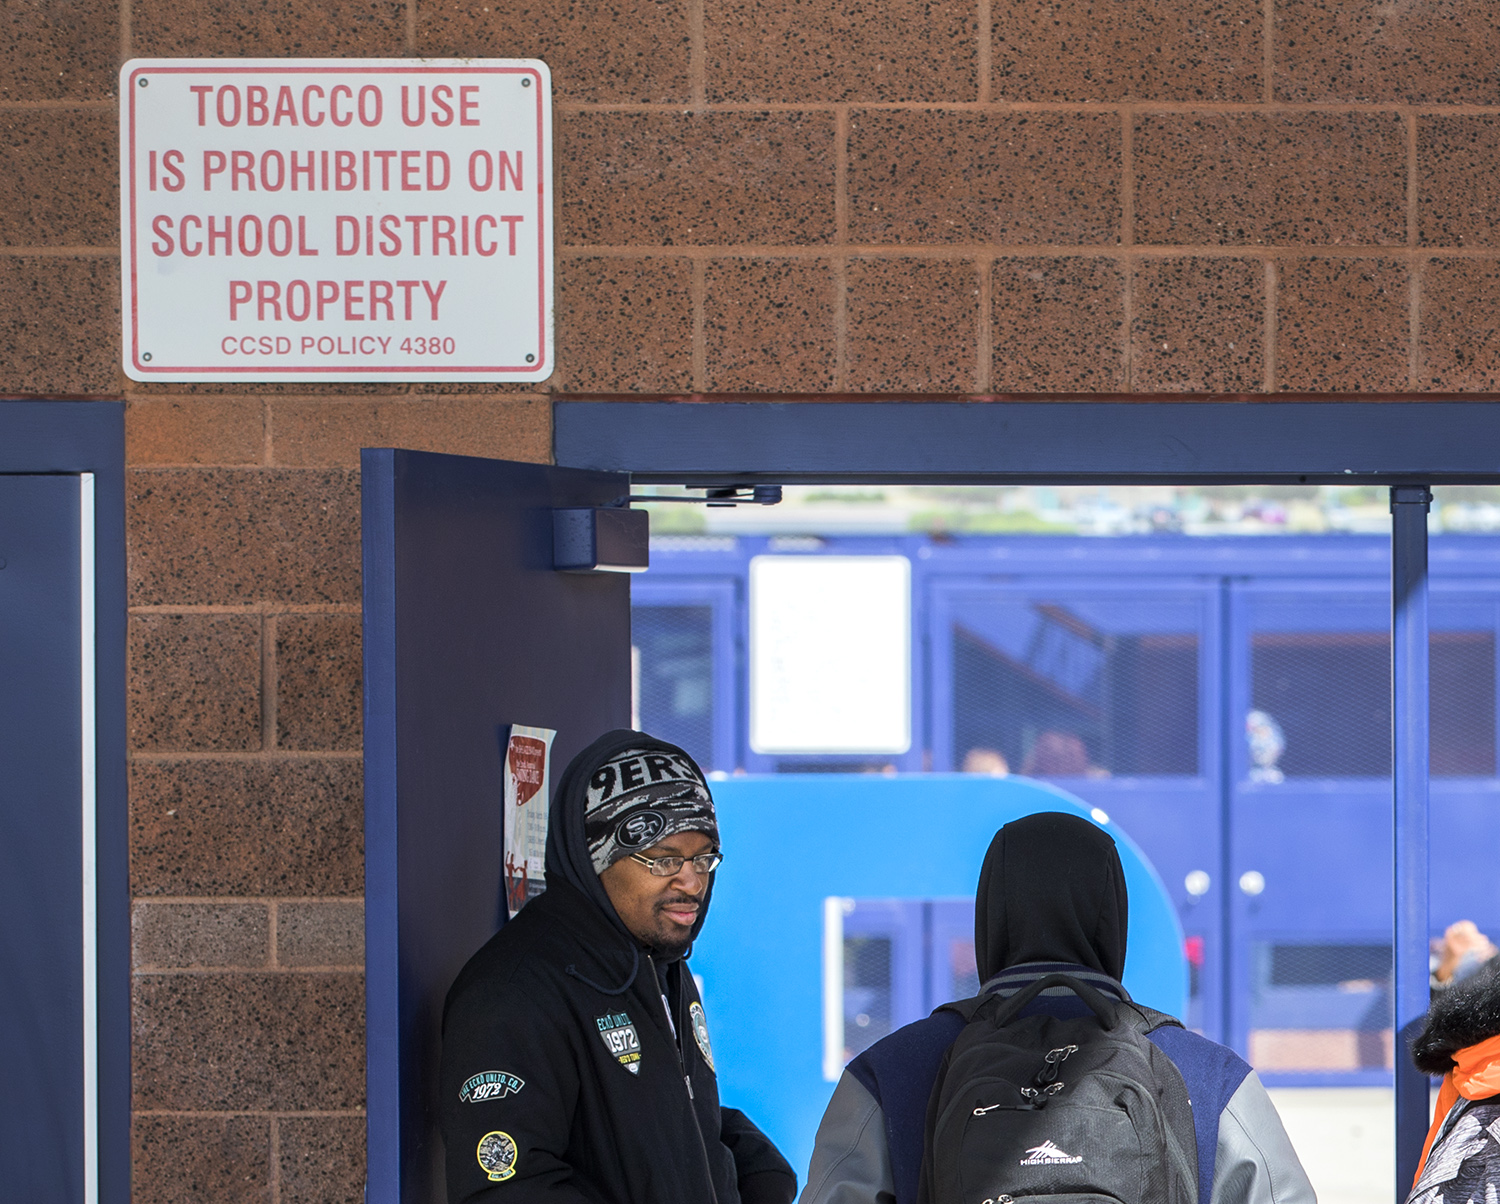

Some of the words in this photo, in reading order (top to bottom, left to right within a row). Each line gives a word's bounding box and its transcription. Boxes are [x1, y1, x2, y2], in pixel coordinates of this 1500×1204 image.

[190, 84, 384, 128] TOBACCO
[401, 85, 480, 128] USE
[149, 150, 185, 192] IS
[203, 150, 451, 192] PROHIBITED
[468, 149, 524, 191] ON
[151, 214, 318, 257] SCHOOL
[336, 214, 524, 257] DISTRICT
[228, 279, 447, 322] PROPERTY
[220, 336, 292, 356] CCSD
[300, 336, 392, 356] POLICY
[399, 336, 456, 356] 4380
[607, 1028, 639, 1053] 1972
[472, 1082, 501, 1100] 1972
[1020, 1158, 1044, 1166] HIGH
